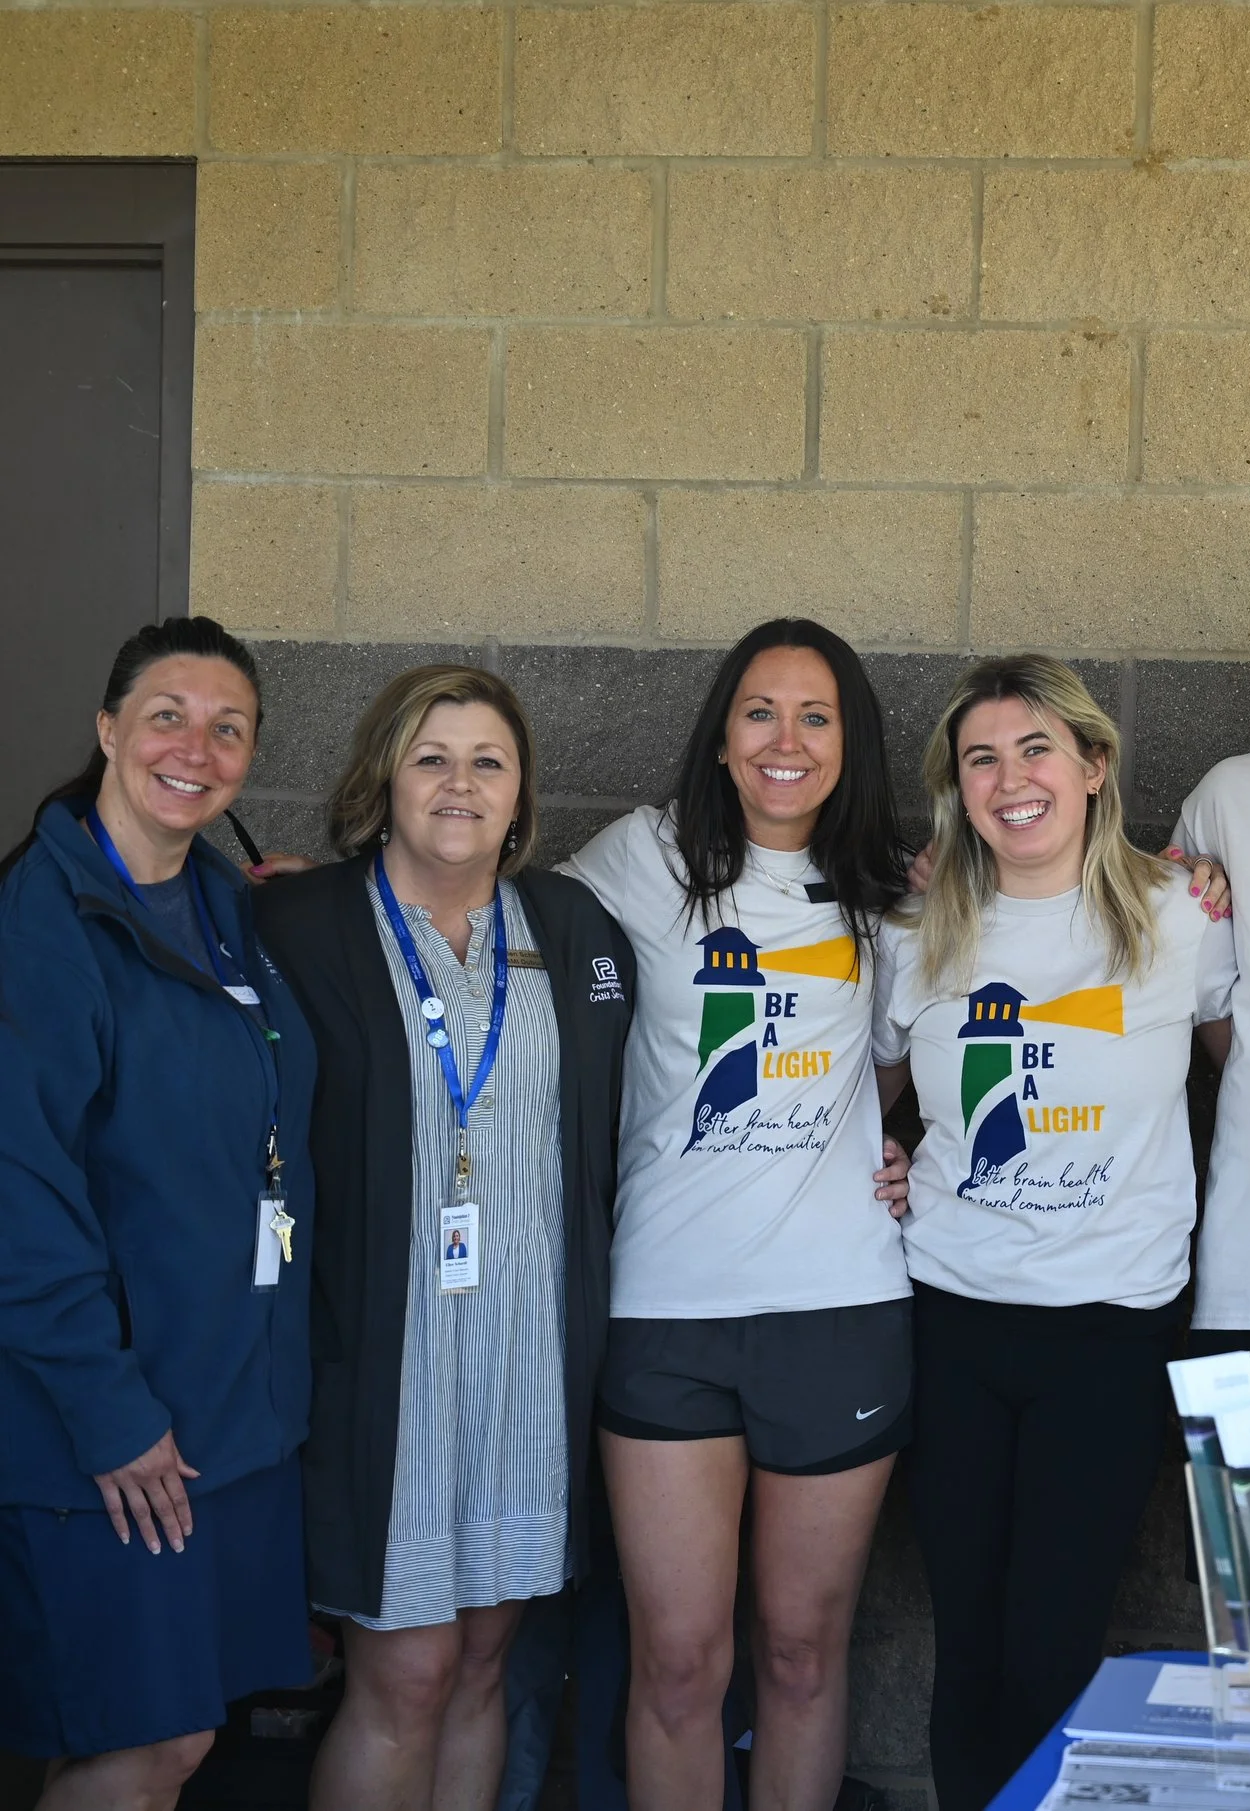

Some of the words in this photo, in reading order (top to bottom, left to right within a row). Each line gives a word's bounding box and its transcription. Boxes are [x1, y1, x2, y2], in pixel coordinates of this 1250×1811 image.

[765, 992, 799, 1018] BE
[762, 1022, 778, 1048] A
[762, 1050, 832, 1079] LIGHT
[1022, 1042, 1055, 1069] BE
[1022, 1074, 1039, 1100] A
[696, 1103, 739, 1135] better
[746, 1108, 783, 1130] brain
[787, 1100, 836, 1129] health
[1026, 1105, 1105, 1133] LIGHT
[692, 1139, 706, 1153] in
[707, 1132, 750, 1153] rural
[747, 1130, 828, 1155] communities
[971, 1156, 1005, 1186] better
[1013, 1162, 1053, 1188] brain
[1059, 1155, 1115, 1188] health
[962, 1188, 977, 1204] in
[979, 1188, 1022, 1211] rural
[1018, 1187, 1106, 1212] communities
